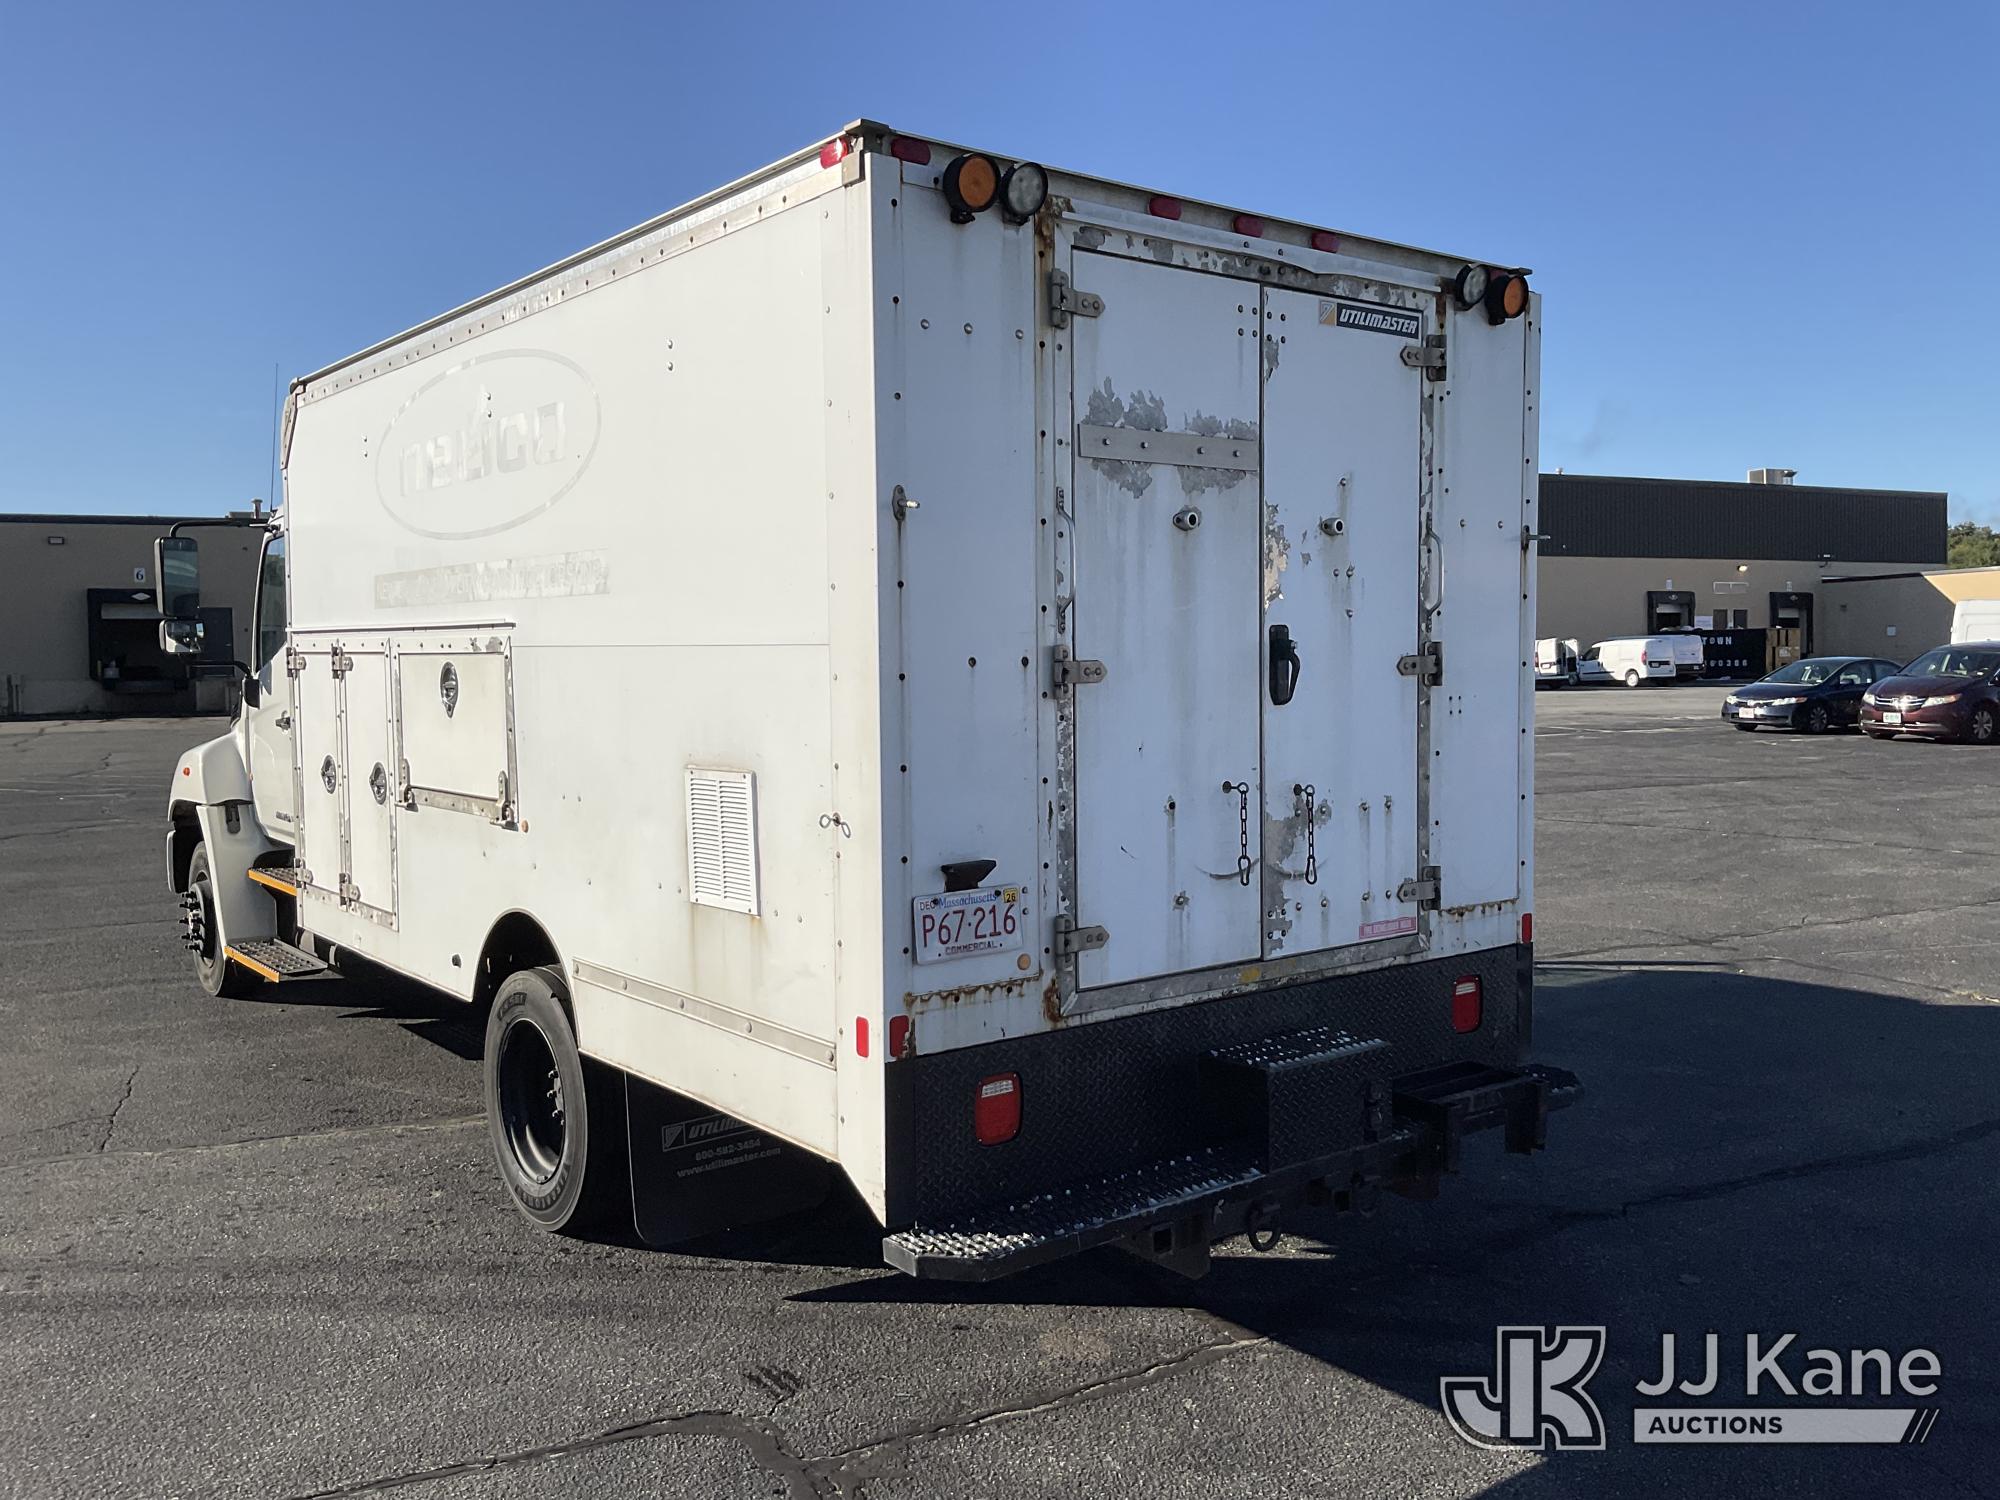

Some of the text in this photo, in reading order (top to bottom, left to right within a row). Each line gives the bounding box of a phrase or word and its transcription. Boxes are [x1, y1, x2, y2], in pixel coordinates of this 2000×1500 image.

[135, 569, 144, 581] 6
[1006, 892, 1016, 903] 26
[945, 941, 998, 955] COMMERCIAL
